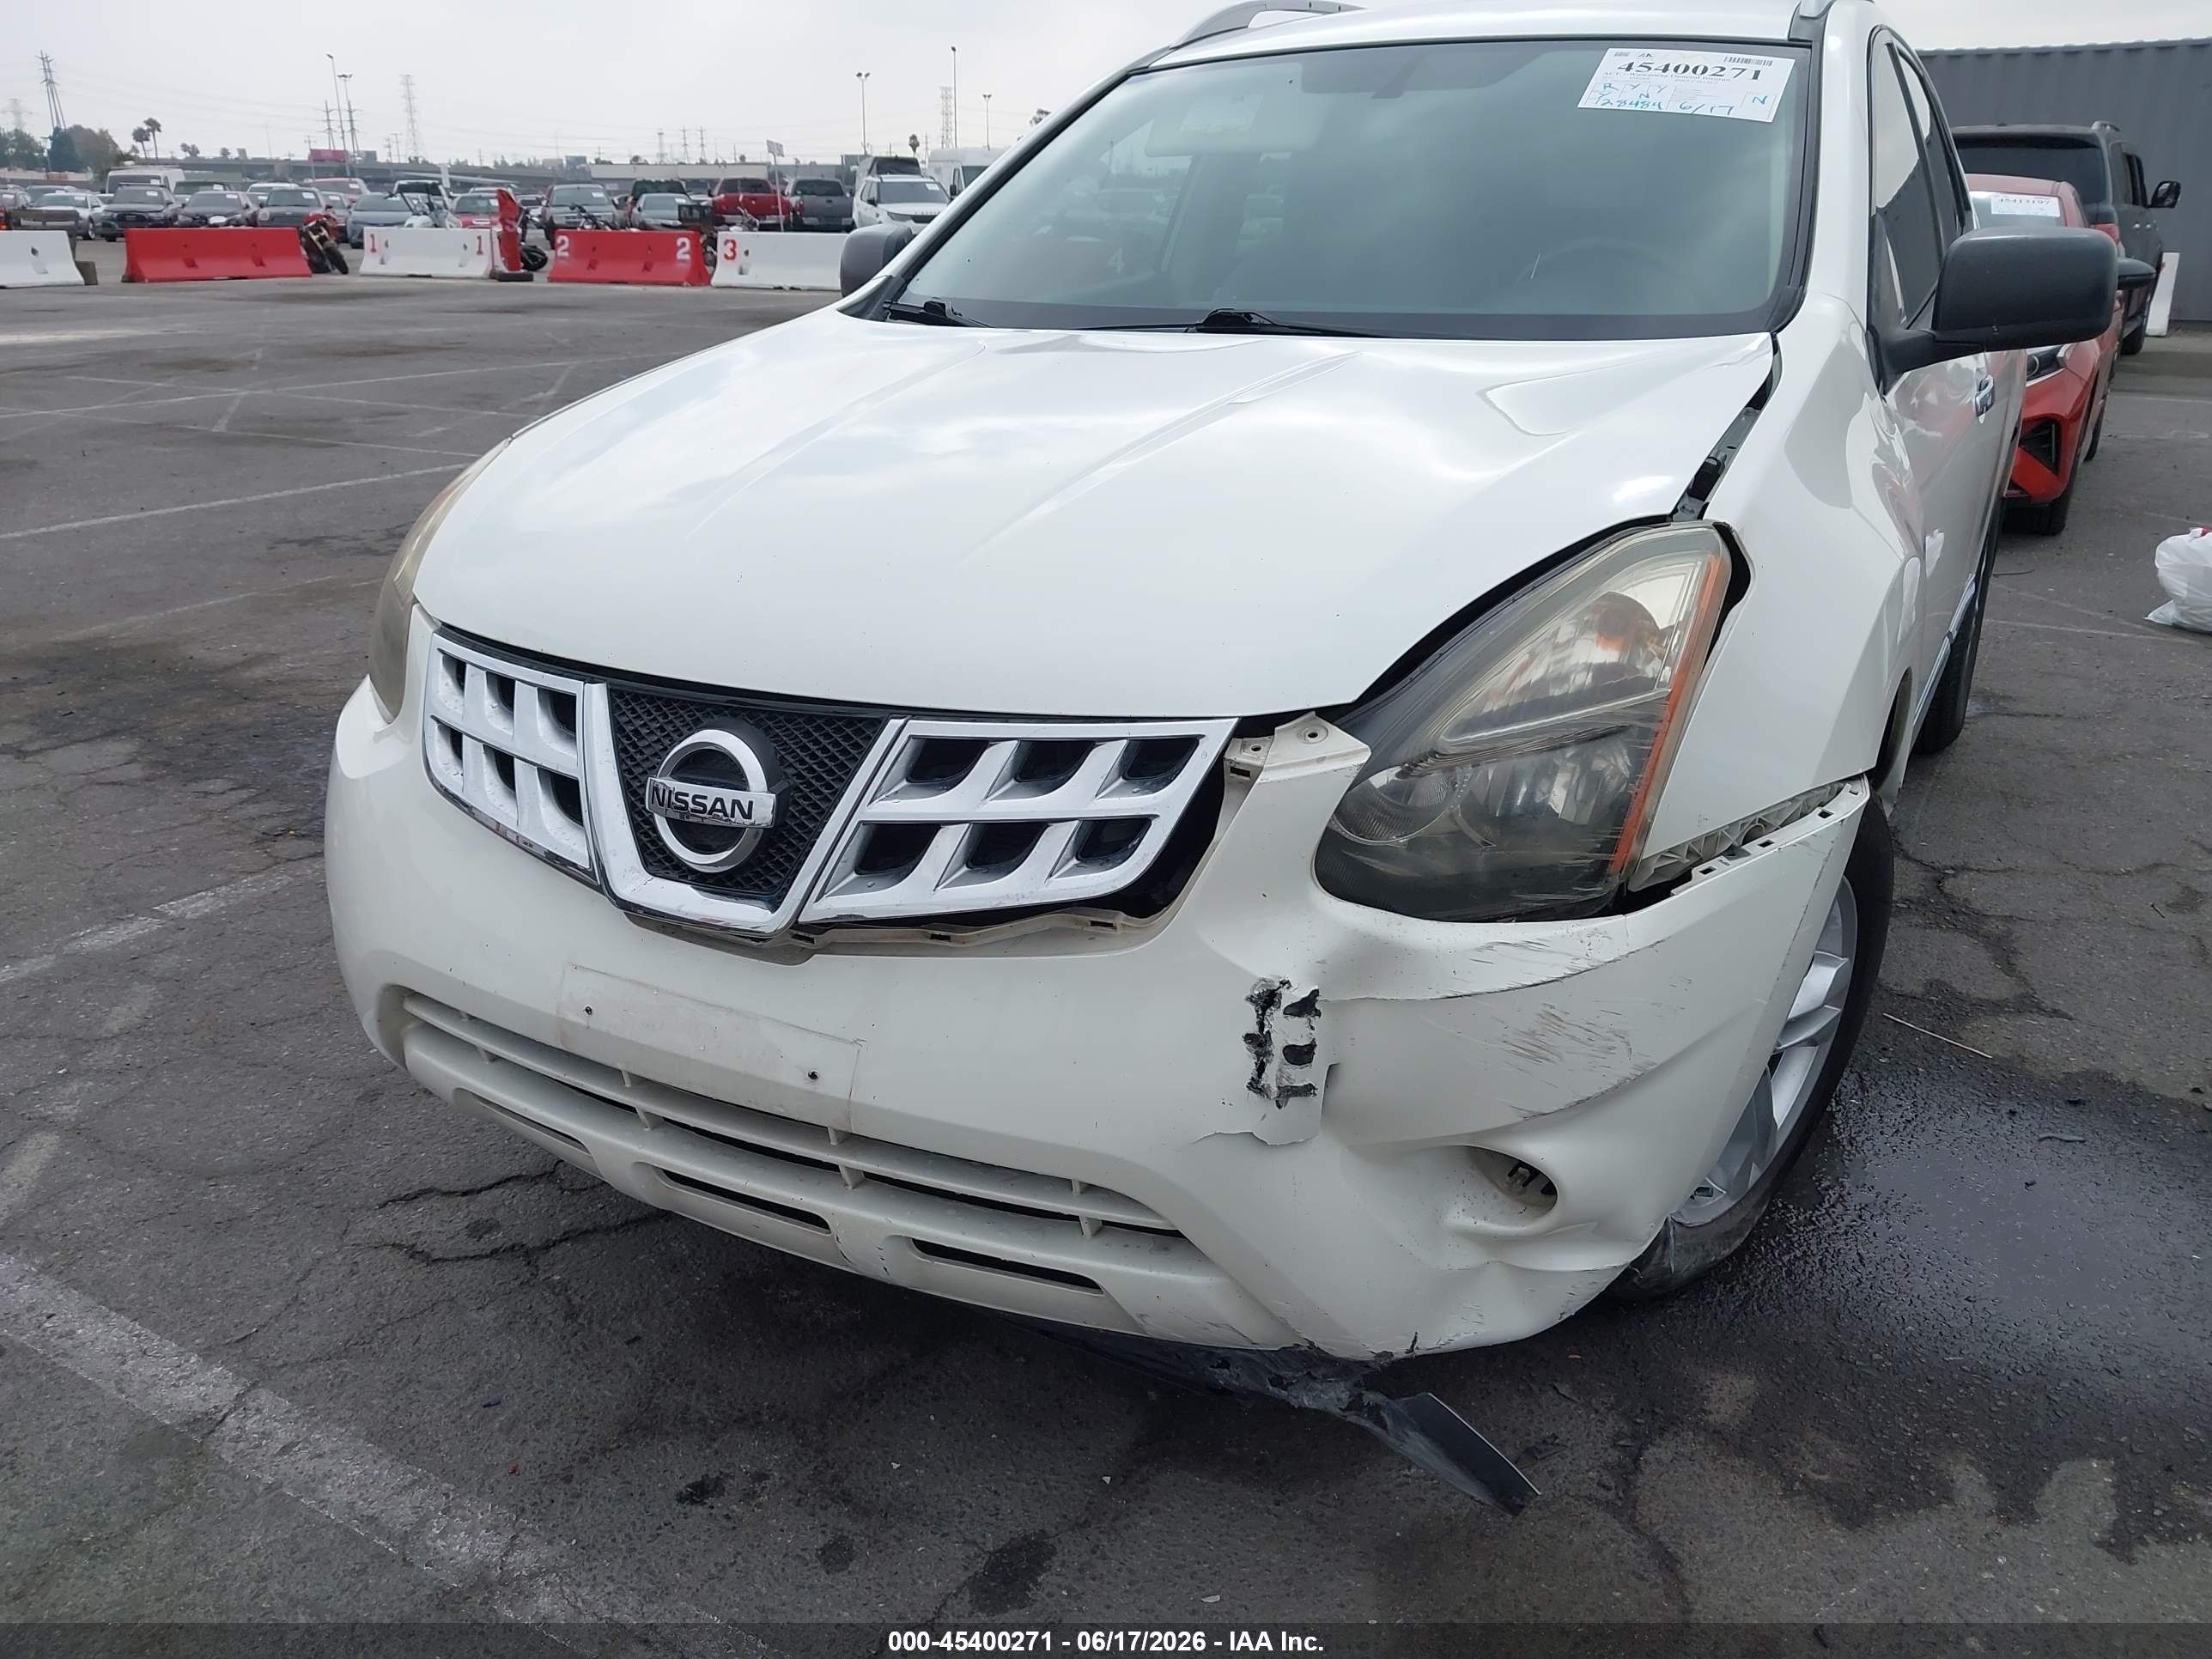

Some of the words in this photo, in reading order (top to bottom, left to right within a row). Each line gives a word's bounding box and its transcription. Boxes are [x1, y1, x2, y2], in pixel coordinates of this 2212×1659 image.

[1618, 61, 1761, 81] 45400271
[1679, 100, 1735, 116] 6/17
[370, 233, 377, 253] 1
[477, 234, 483, 255] 1
[556, 234, 570, 257] 2
[676, 236, 691, 259] 2
[723, 238, 738, 261] 3
[651, 787, 754, 820] NISSAN
